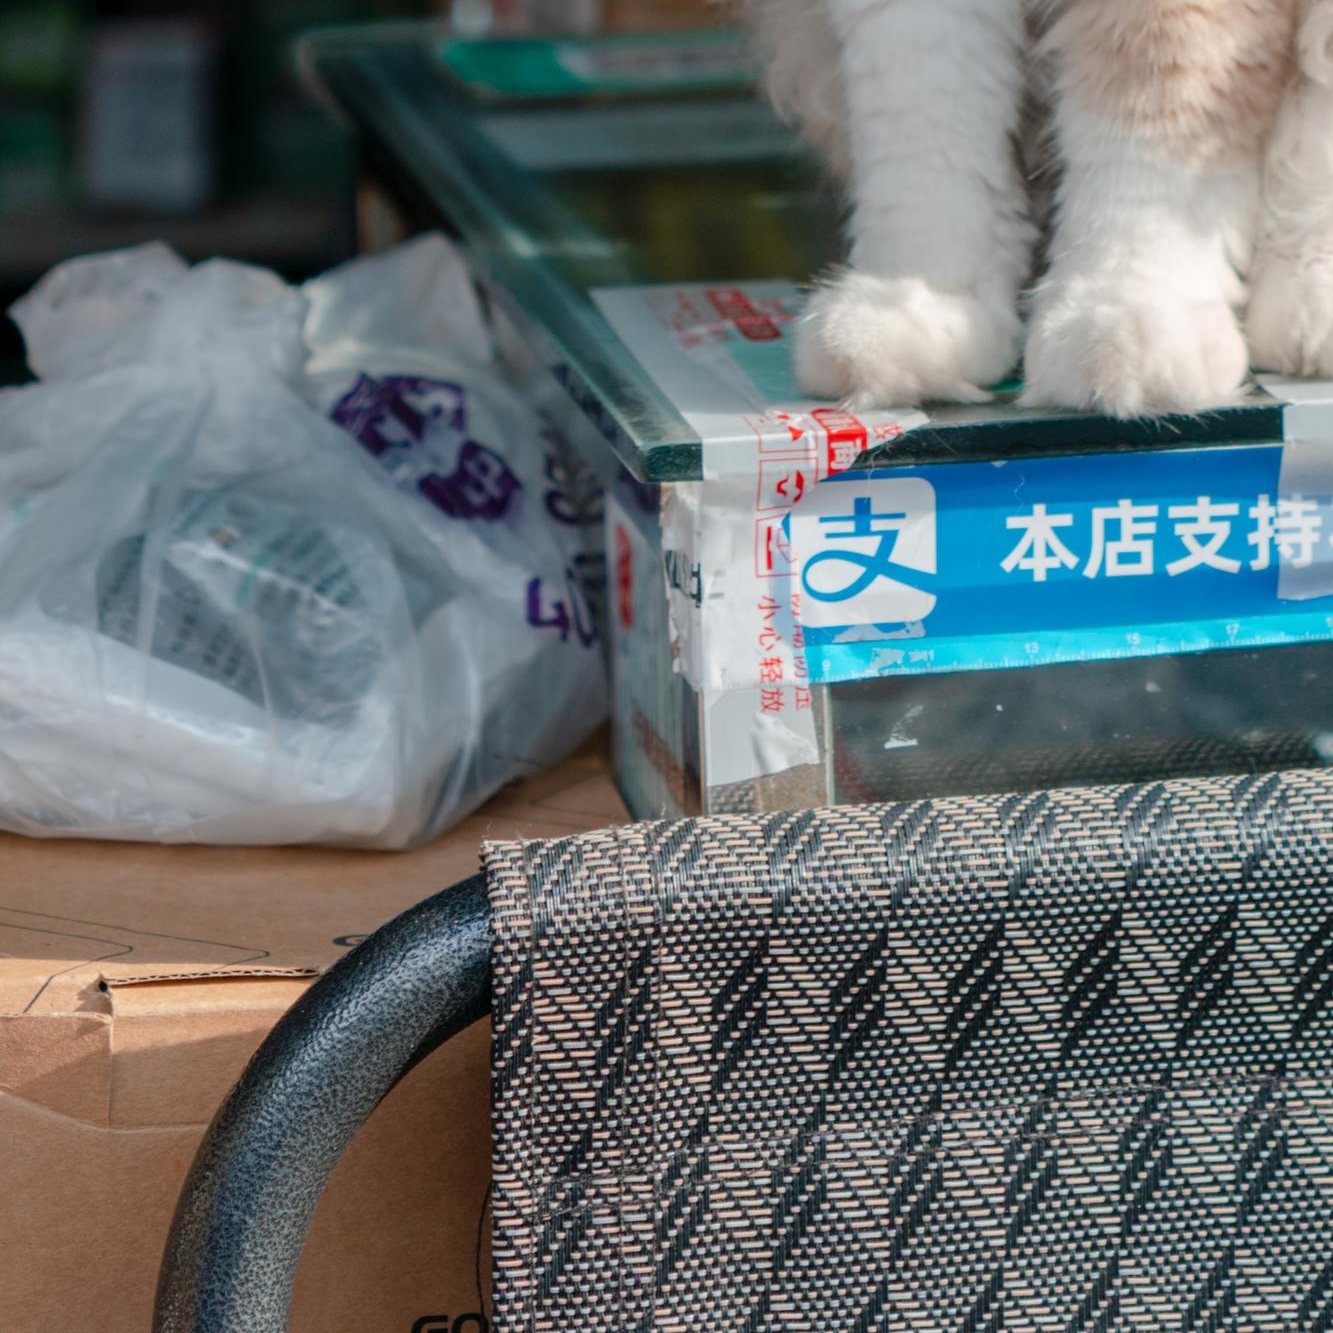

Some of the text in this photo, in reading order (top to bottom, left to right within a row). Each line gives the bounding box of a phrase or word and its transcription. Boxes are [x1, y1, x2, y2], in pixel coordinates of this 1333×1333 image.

[757, 595, 785, 714] 小心轻放
[1023, 641, 1039, 654] 13
[1125, 633, 1140, 646] 15
[1225, 623, 1240, 636] 17
